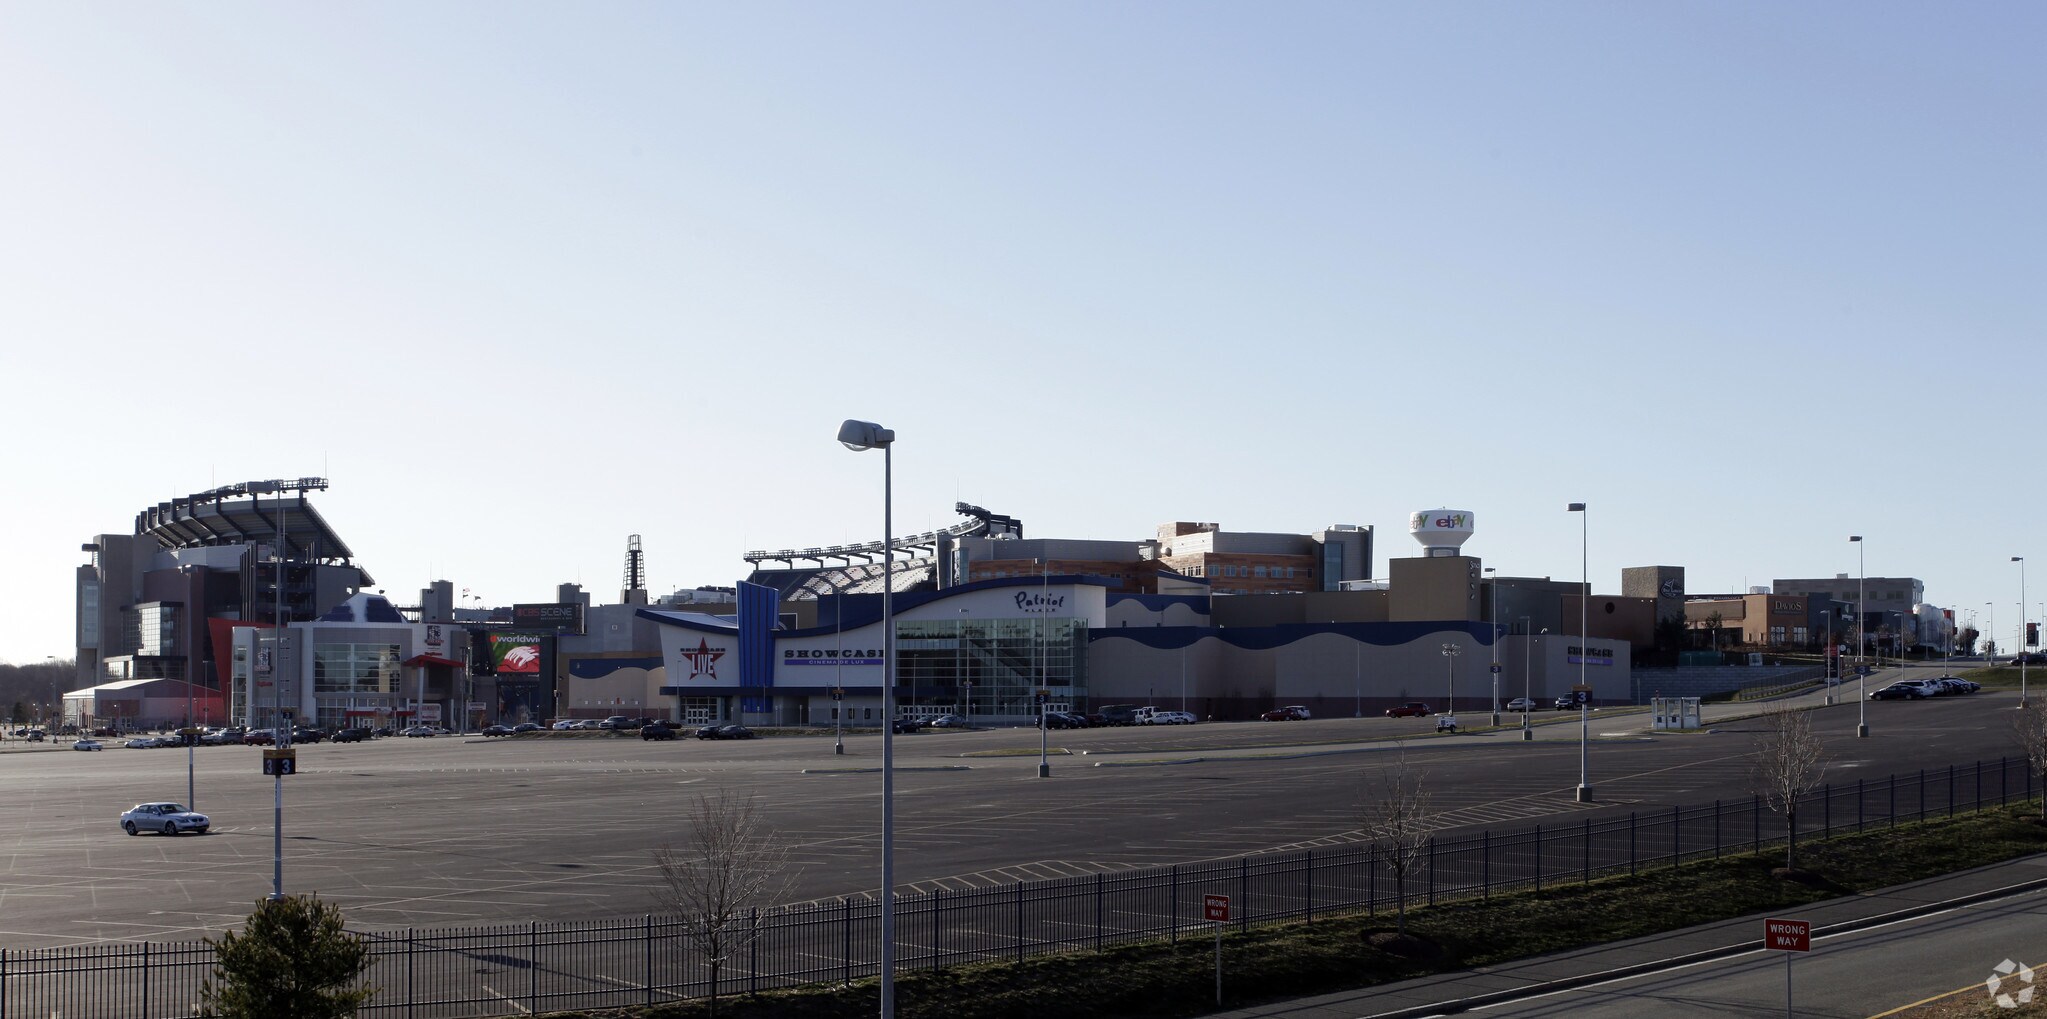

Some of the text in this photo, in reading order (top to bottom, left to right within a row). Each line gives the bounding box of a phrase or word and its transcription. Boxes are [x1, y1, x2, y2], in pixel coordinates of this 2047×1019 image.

[1014, 591, 1064, 609] Patriot
[523, 607, 572, 616] CBS SCENE
[692, 654, 713, 674] LIVE
[1578, 692, 1587, 702] 3
[183, 735, 188, 743] 3
[194, 735, 199, 743] 3
[266, 759, 273, 774] 3
[282, 759, 290, 774] 3
[1206, 899, 1227, 908] WRONG
[1211, 909, 1223, 917] WAY
[1770, 924, 1805, 935] WRONG
[1777, 936, 1798, 946] WAY
